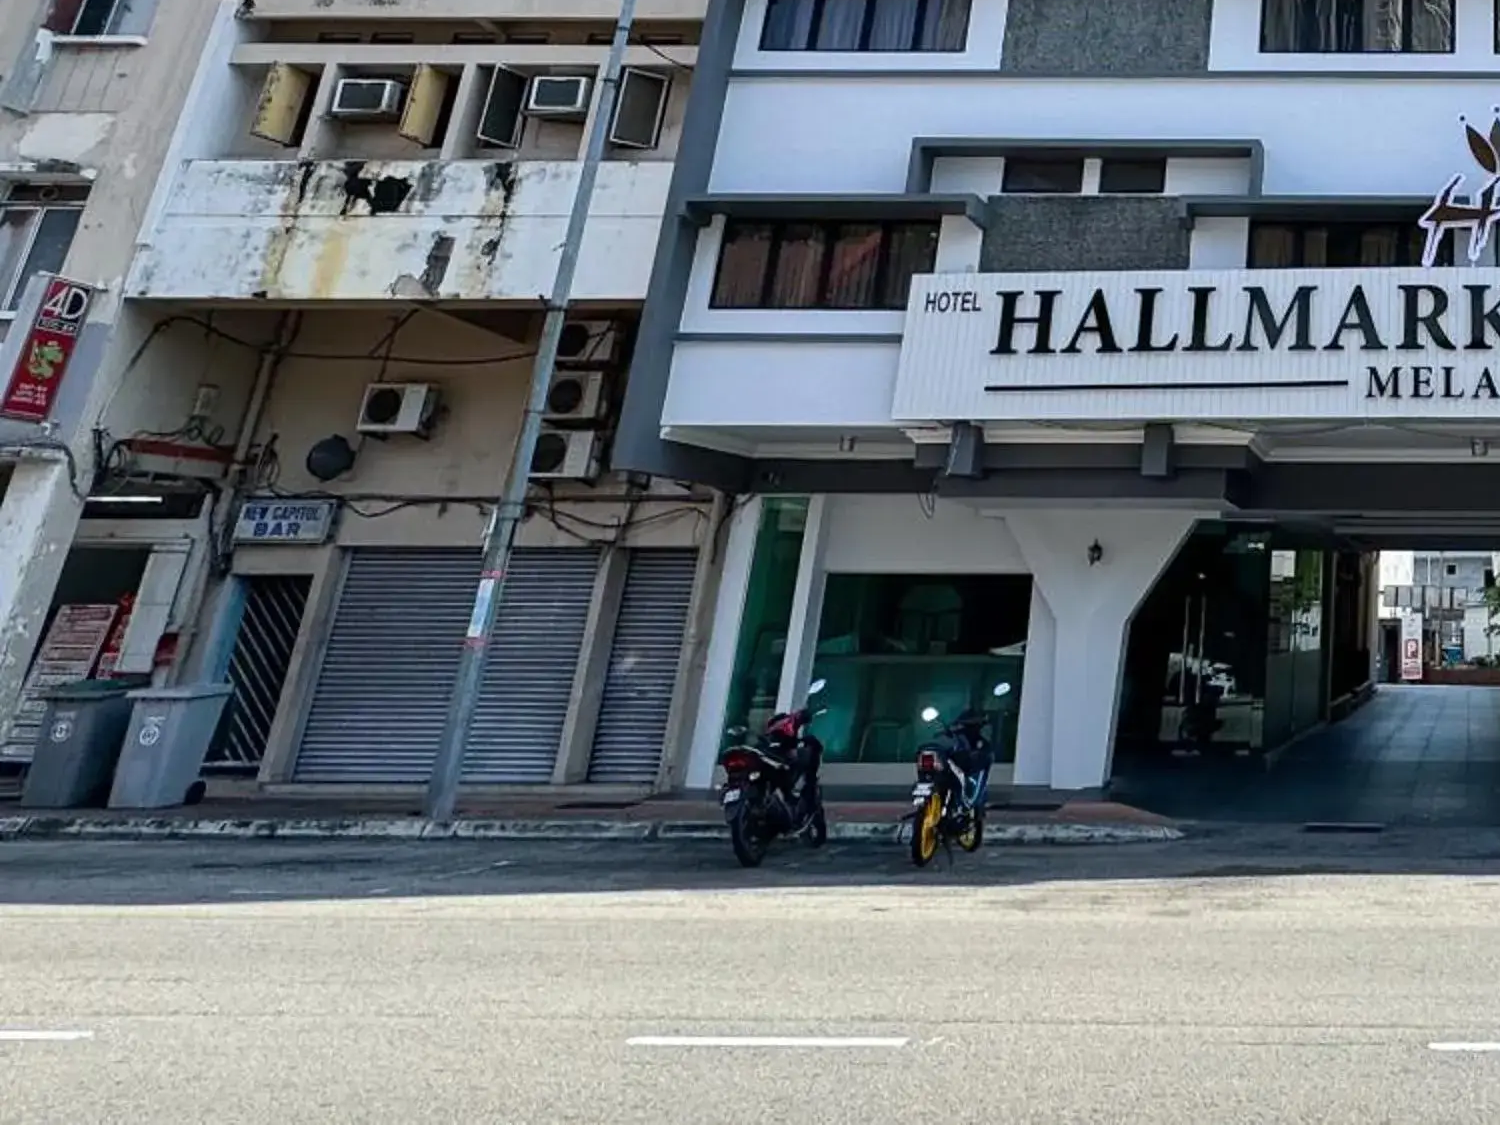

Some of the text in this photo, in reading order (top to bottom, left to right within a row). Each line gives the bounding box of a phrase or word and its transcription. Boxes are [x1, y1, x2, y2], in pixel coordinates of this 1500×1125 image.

[41, 286, 88, 319] 4D
[925, 291, 982, 313] HOTEL
[254, 522, 300, 537] BAR
